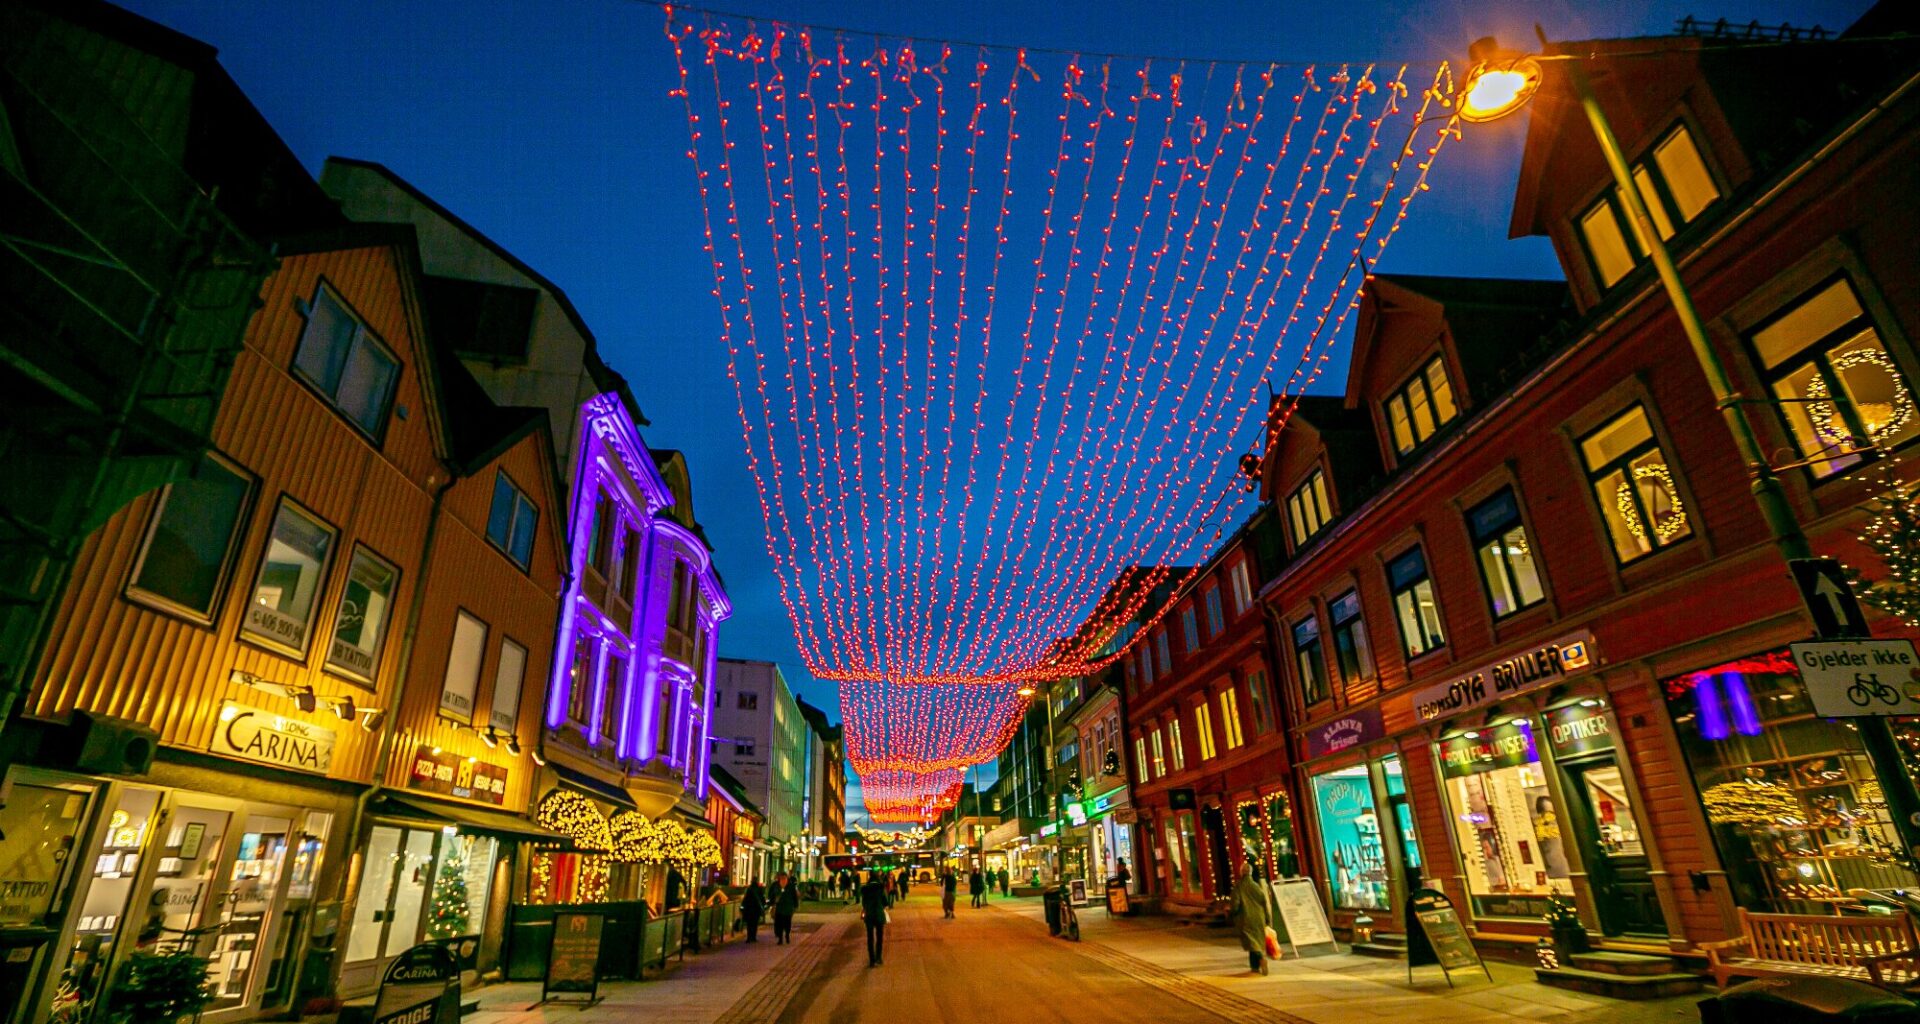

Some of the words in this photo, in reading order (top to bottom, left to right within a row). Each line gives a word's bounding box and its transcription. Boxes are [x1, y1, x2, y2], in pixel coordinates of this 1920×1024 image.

[1492, 644, 1566, 692] BRILLER
[1802, 650, 1868, 671] Gjelder
[1871, 649, 1911, 665] ikke
[226, 712, 318, 768] CARINA
[1323, 719, 1363, 742] ALANYA
[1552, 715, 1609, 744] OPTIKER
[2, 880, 49, 897] TATTOO
[393, 966, 437, 980] CARINA
